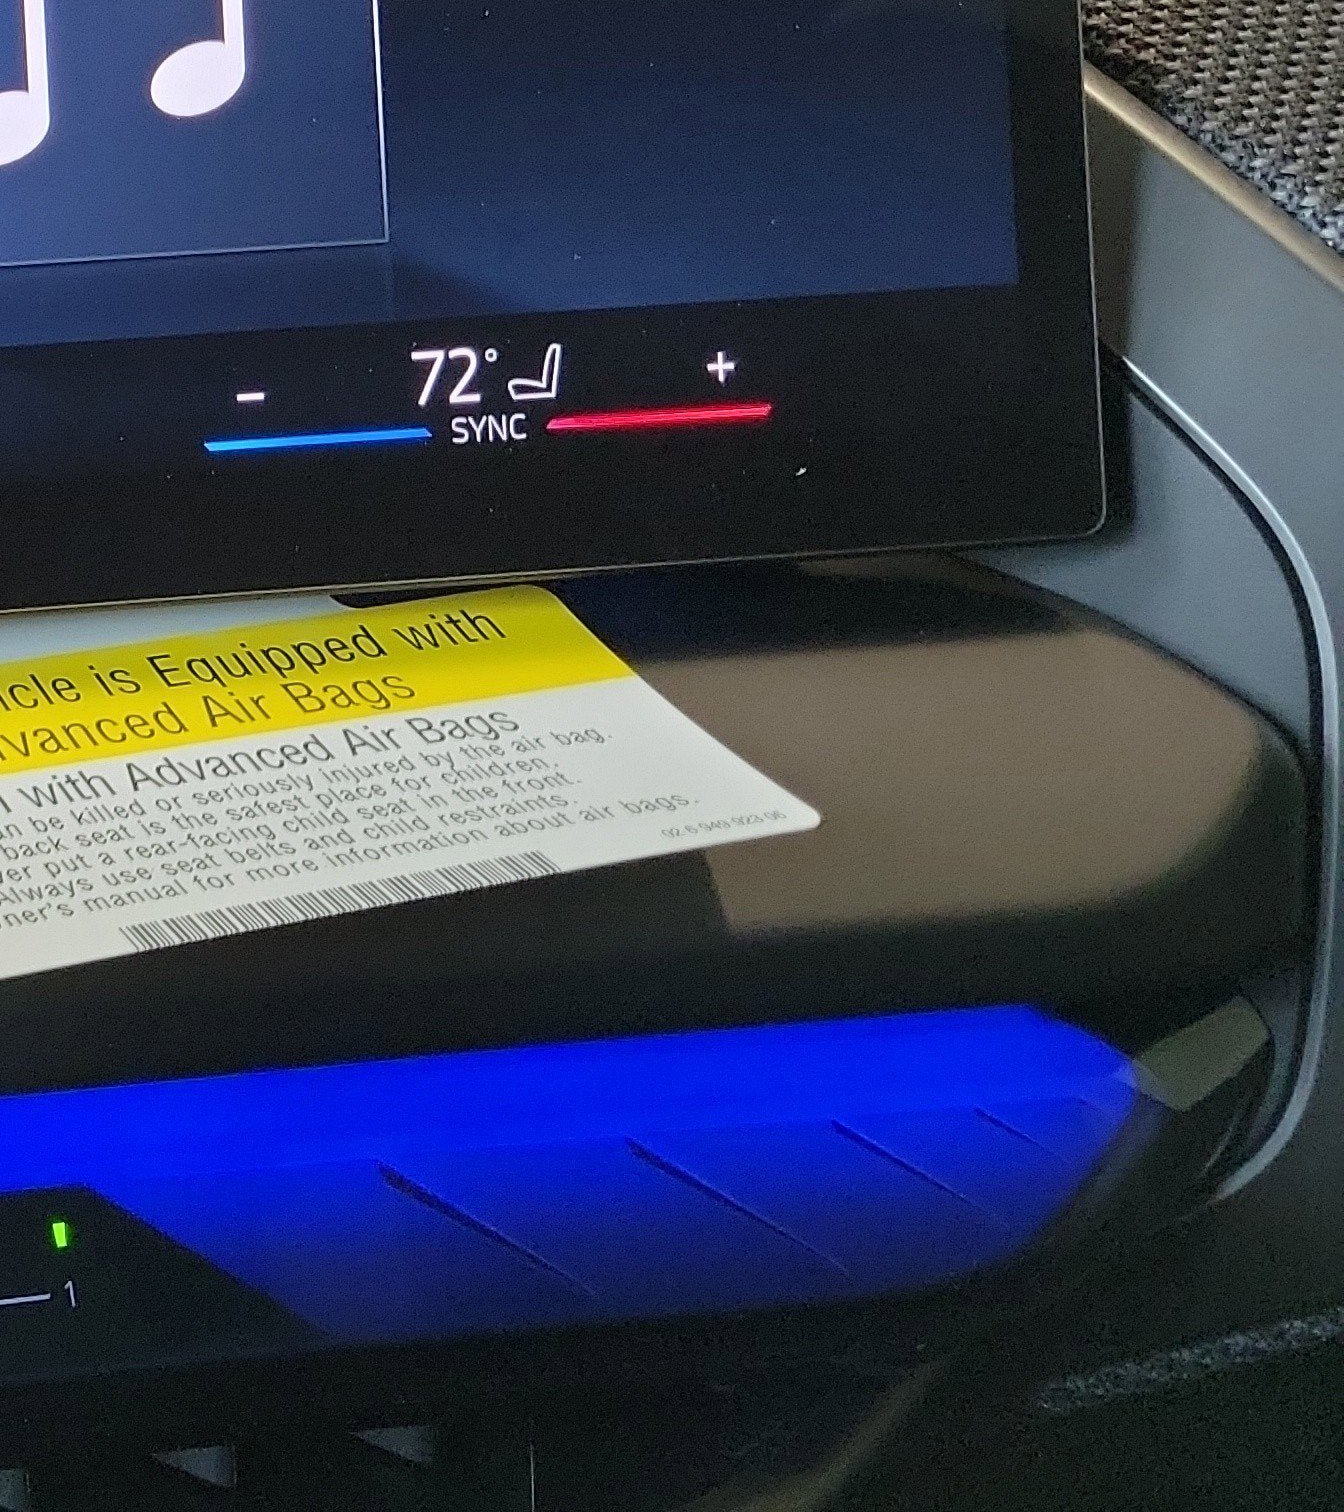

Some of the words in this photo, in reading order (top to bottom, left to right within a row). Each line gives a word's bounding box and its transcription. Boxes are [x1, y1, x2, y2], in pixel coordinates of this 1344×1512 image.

[451, 412, 527, 444] SYNC
[89, 664, 140, 698] is
[146, 624, 387, 684] Equipped
[392, 608, 507, 650] with
[202, 679, 272, 728] Air
[281, 671, 416, 716] Bags
[17, 770, 116, 807] with
[126, 733, 336, 791] Advanced
[342, 724, 403, 756] Air
[406, 710, 519, 744] Bags
[28, 815, 64, 832] be
[70, 799, 146, 825] killed
[156, 795, 183, 812] or
[192, 773, 313, 805] seriously
[318, 755, 416, 784] injured
[422, 750, 456, 770] by
[460, 744, 505, 761] the
[511, 736, 545, 755] air
[550, 728, 613, 745] bag.
[1, 836, 69, 860] back
[76, 823, 135, 848] seat
[137, 820, 166, 836] is
[172, 813, 217, 830] the
[226, 794, 310, 821] safest
[316, 783, 387, 809] place
[392, 774, 432, 792] for
[441, 755, 559, 784] children.
[44, 853, 91, 878] put
[98, 851, 116, 865] a
[125, 821, 276, 862] rear-facing
[283, 808, 349, 833] child
[358, 798, 421, 819] seat
[425, 791, 445, 808] in
[460, 784, 499, 801] the
[502, 773, 582, 796] front.
[83, 880, 188, 912] manual
[193, 871, 235, 891] for
[245, 858, 319, 882] more
[324, 829, 492, 867] information
[494, 811, 576, 837] about
[579, 804, 616, 822] air
[618, 793, 700, 814] bags.
[102, 866, 152, 886] use
[161, 851, 222, 876] seat
[224, 840, 296, 864] belts
[303, 829, 355, 850] and
[363, 815, 430, 839] child
[439, 793, 578, 826] restraints.
[64, 1280, 76, 1308] 1
